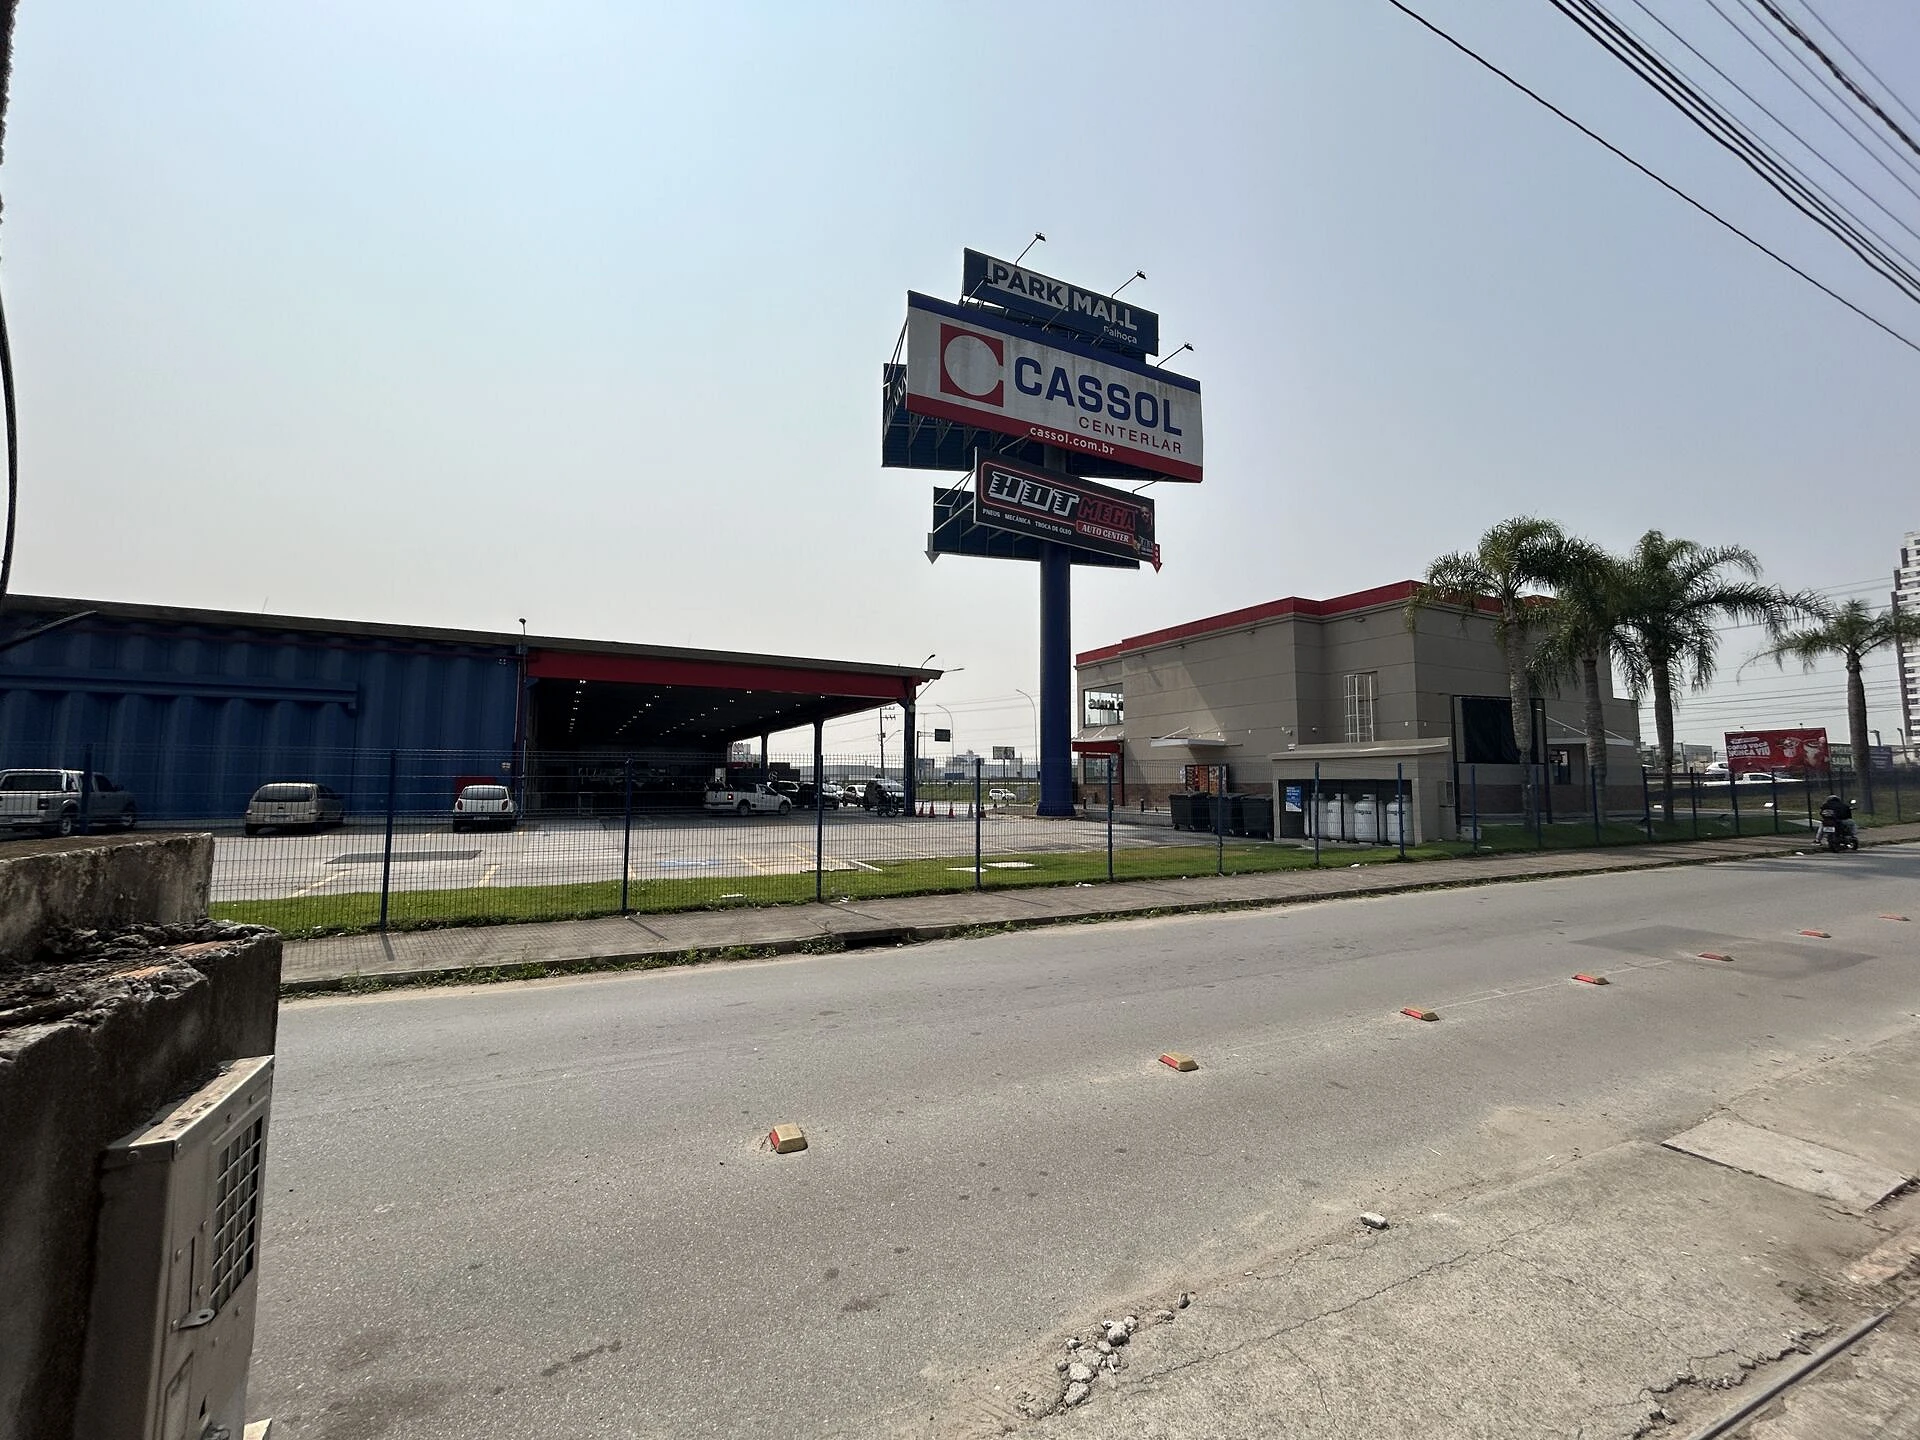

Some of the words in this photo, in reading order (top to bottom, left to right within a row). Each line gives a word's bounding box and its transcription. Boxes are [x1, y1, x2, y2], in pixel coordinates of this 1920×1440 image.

[991, 263, 1065, 306] PARK
[1073, 292, 1138, 331] MALL
[1103, 325, 1138, 345] Palhoça
[1014, 356, 1182, 437] CASSOL
[1029, 425, 1115, 456] cassol.com.br
[1079, 416, 1183, 455] CENTERLAR
[988, 471, 1080, 517] HOT
[1077, 496, 1136, 531] MEGA
[982, 508, 1001, 518] PNEUS
[1004, 513, 1031, 525] MECÂNICA
[1035, 520, 1051, 531] TROCA
[1081, 524, 1102, 536] AUTO
[1102, 529, 1129, 543] CENTER
